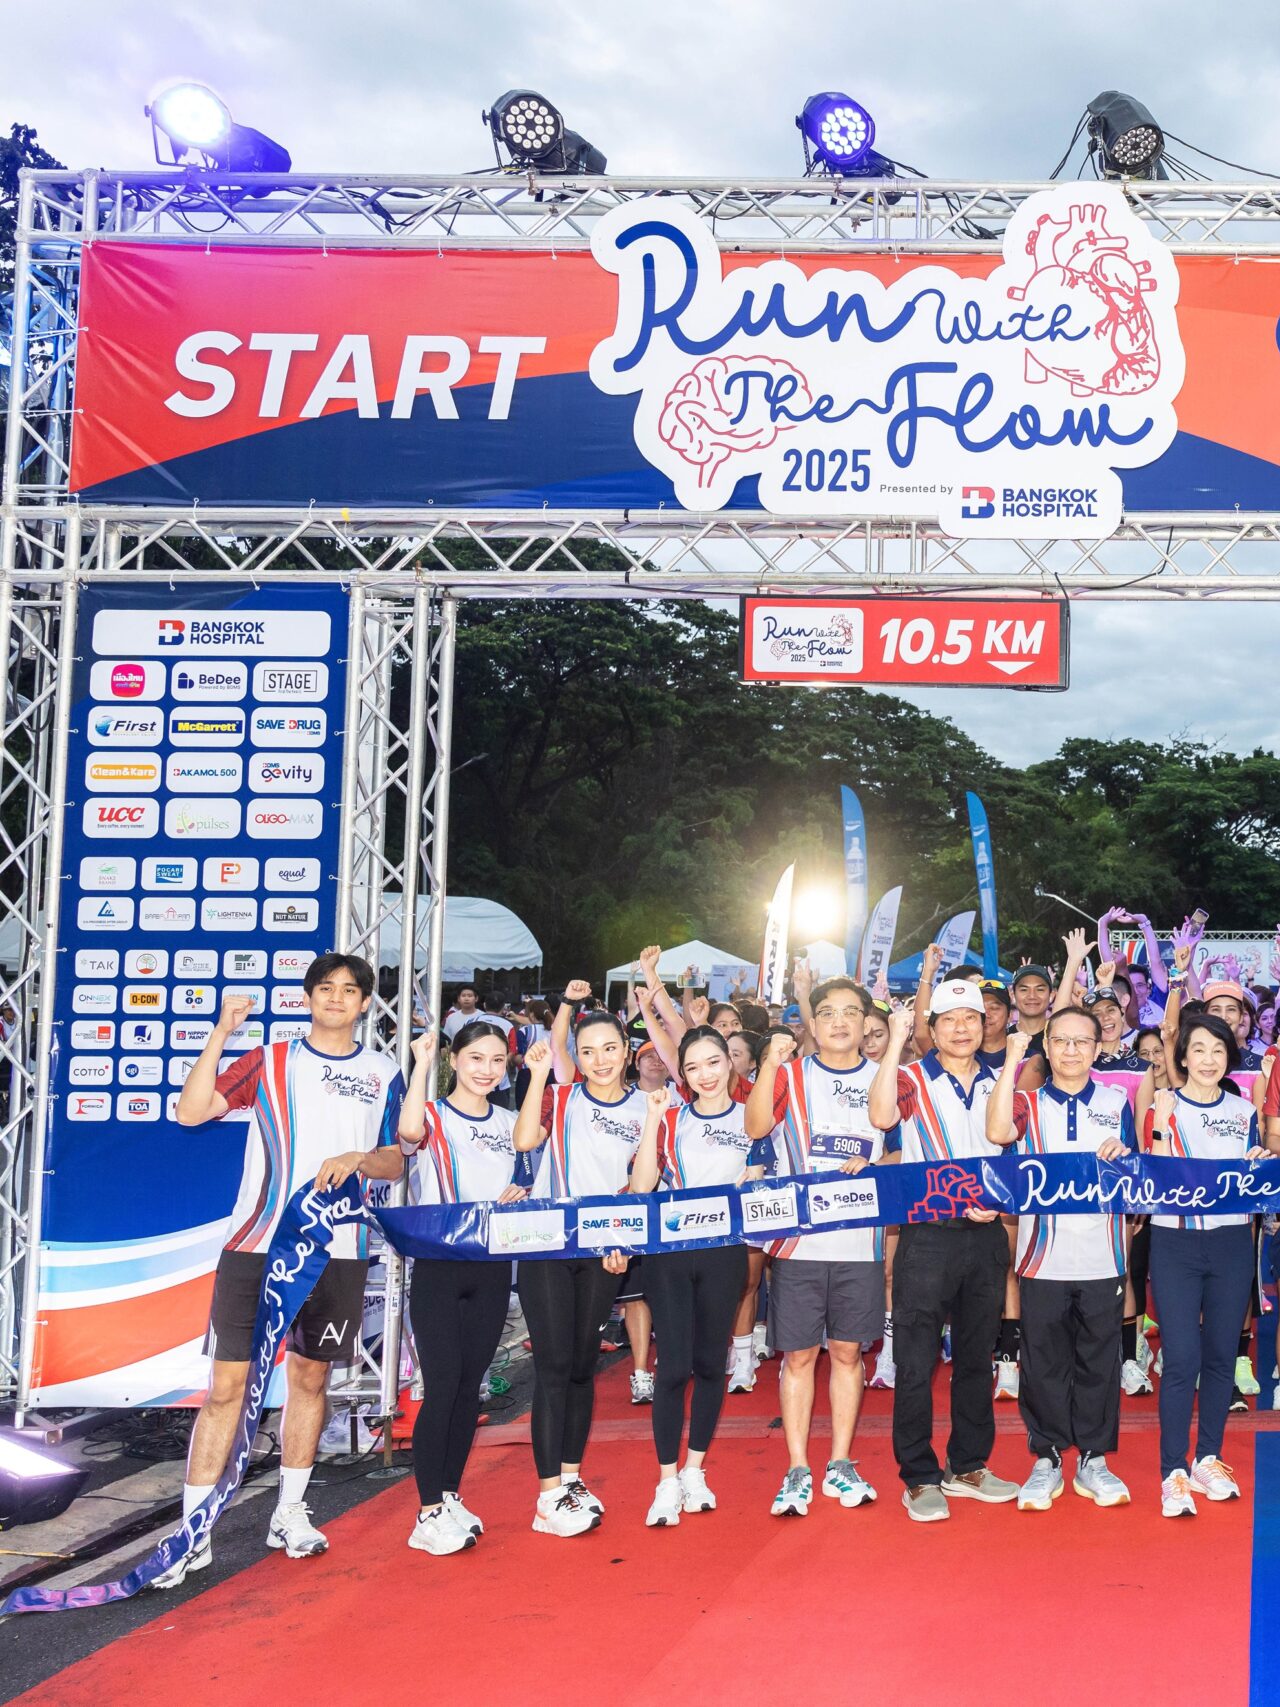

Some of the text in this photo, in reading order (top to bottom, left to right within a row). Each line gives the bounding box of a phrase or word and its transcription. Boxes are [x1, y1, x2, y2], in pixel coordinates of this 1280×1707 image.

[613, 221, 1091, 373] Run With
[163, 331, 546, 419] START
[725, 362, 1154, 468] The Flow
[783, 449, 871, 493] 2025
[879, 483, 954, 496] Presented by
[1002, 488, 1098, 502] BANGKOK
[1002, 503, 1098, 518] HOSPITAL
[191, 622, 265, 633] BANGKOK
[763, 616, 813, 641] Run
[190, 633, 265, 645] HOSPITAL
[879, 618, 1045, 665] 10.5 KM
[807, 640, 852, 657] Flow
[791, 654, 806, 662] 2025
[199, 674, 241, 684] BeDee
[268, 673, 312, 689] STAGE
[114, 720, 157, 731] First
[177, 722, 237, 731] McGarrett
[256, 719, 321, 730] SAVE DRUG
[92, 767, 156, 777] Klean&Kare
[220, 768, 237, 777] 500
[196, 818, 230, 832] pulses
[279, 867, 306, 881] equal
[89, 961, 114, 970] TAK
[132, 995, 158, 1003] O-CON
[73, 1068, 106, 1077] COTTO
[320, 1065, 357, 1082] Run
[832, 1080, 864, 1095] Run
[129, 1103, 148, 1111] TOA
[1201, 1114, 1228, 1128] Run
[702, 1124, 729, 1137] Run
[833, 1137, 862, 1154] 5906
[1019, 1159, 1113, 1212] Run
[582, 1217, 643, 1230] SAVE DRUG
[683, 1210, 725, 1226] First
